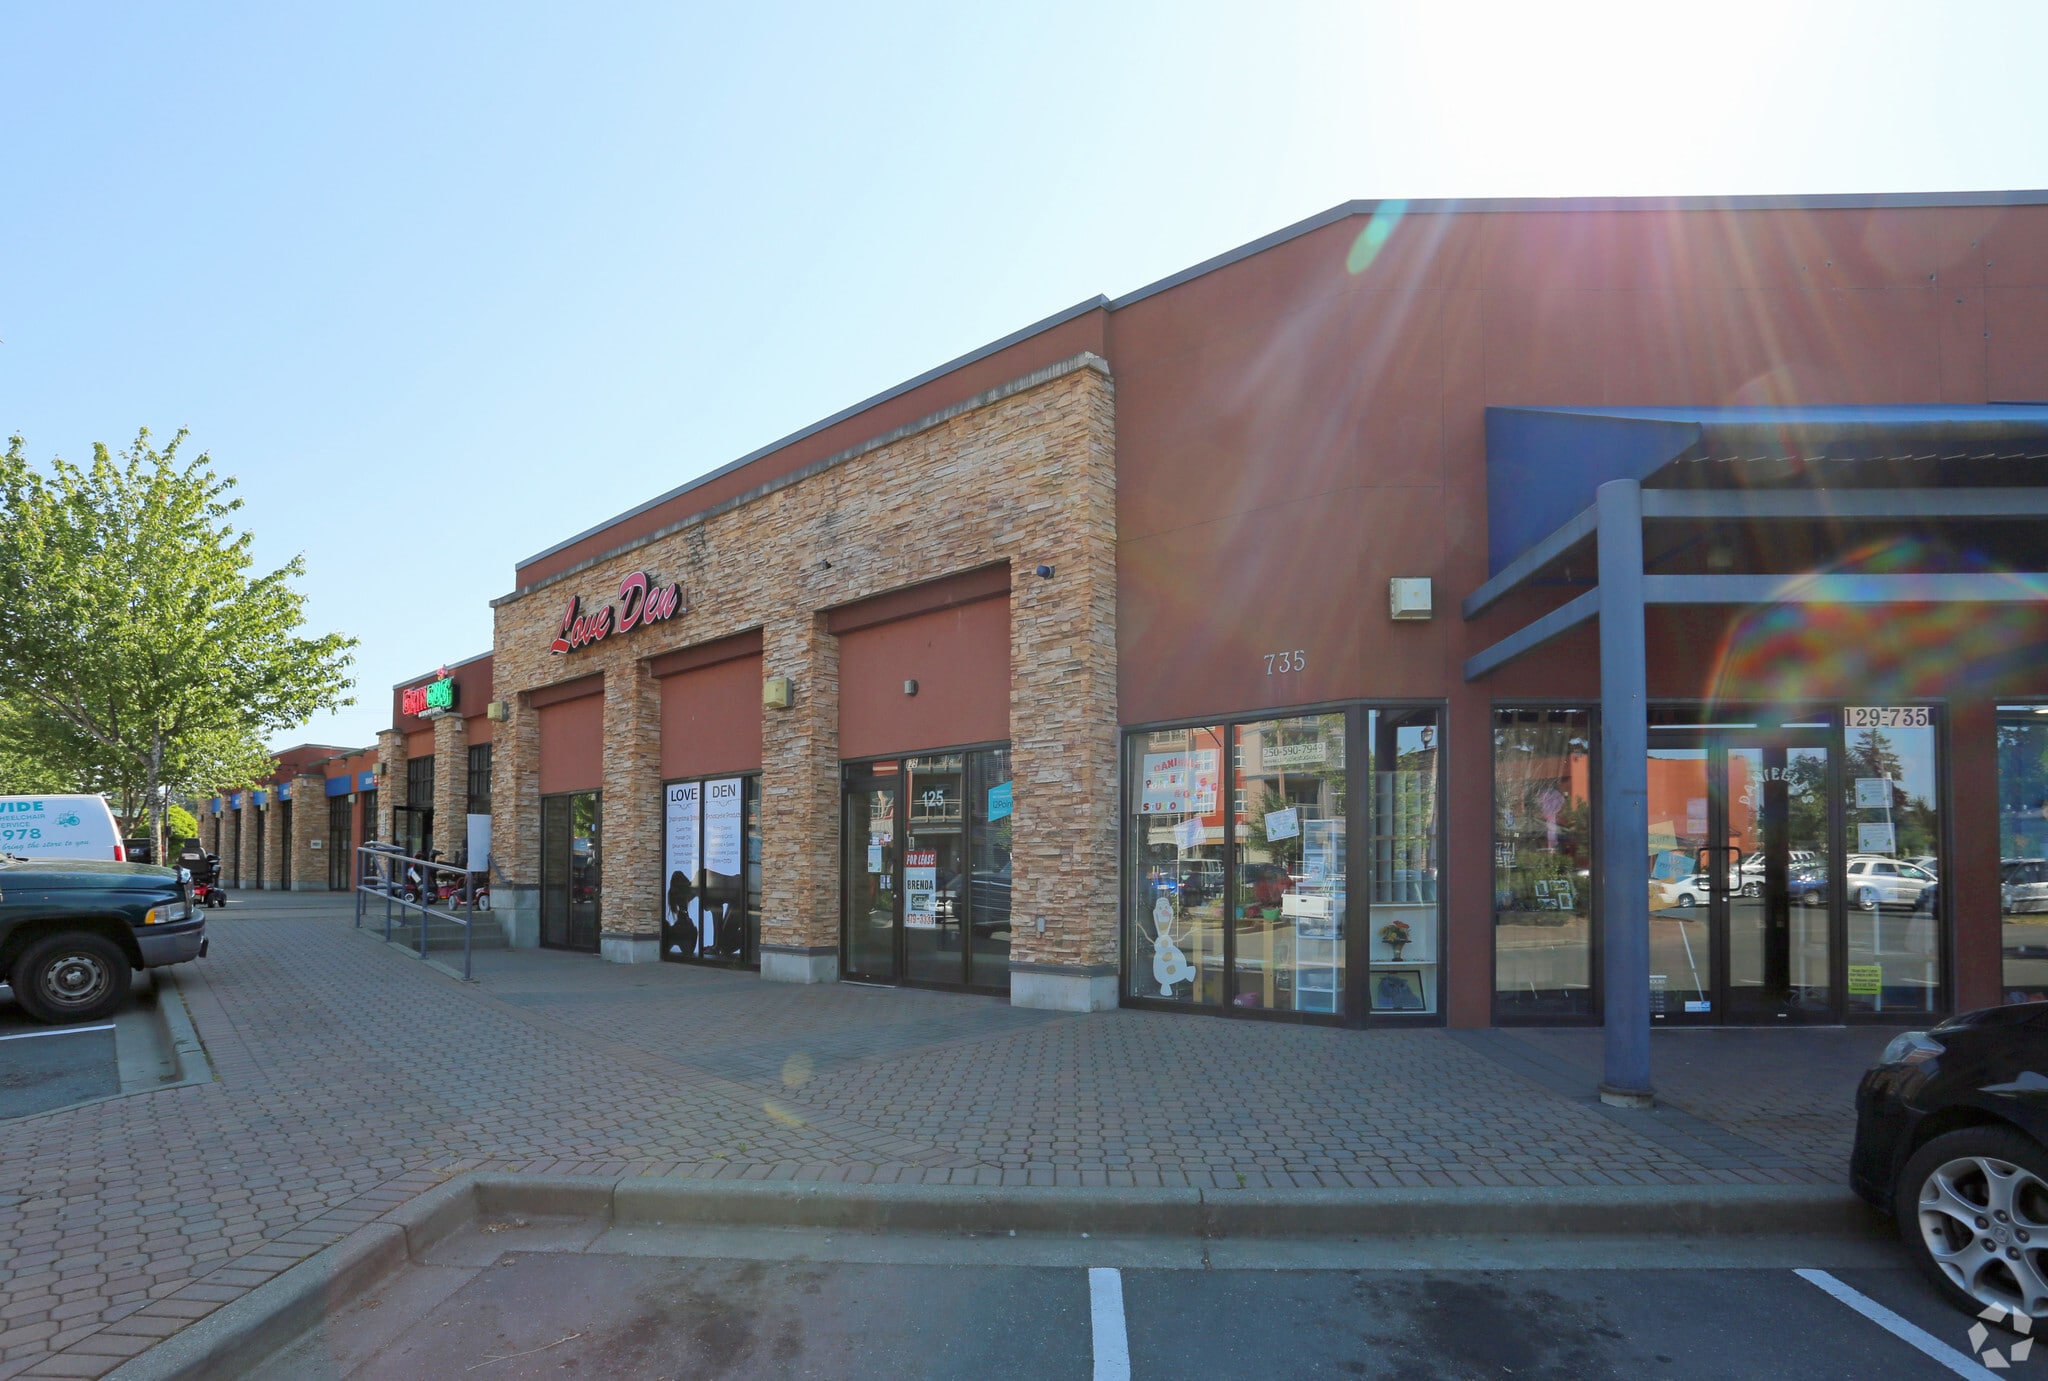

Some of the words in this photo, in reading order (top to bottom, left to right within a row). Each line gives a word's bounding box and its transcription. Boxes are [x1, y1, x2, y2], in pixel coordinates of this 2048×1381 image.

[550, 595, 612, 654] Love
[619, 571, 680, 633] Den
[1264, 650, 1306, 675] 735
[671, 788, 698, 802] LOVE
[712, 784, 736, 798] DEN
[922, 790, 944, 807] 125
[27, 841, 40, 849] the
[42, 840, 61, 848] store
[906, 855, 918, 865] FOR
[918, 854, 935, 865] LEASE
[907, 880, 934, 890] BRENDA
